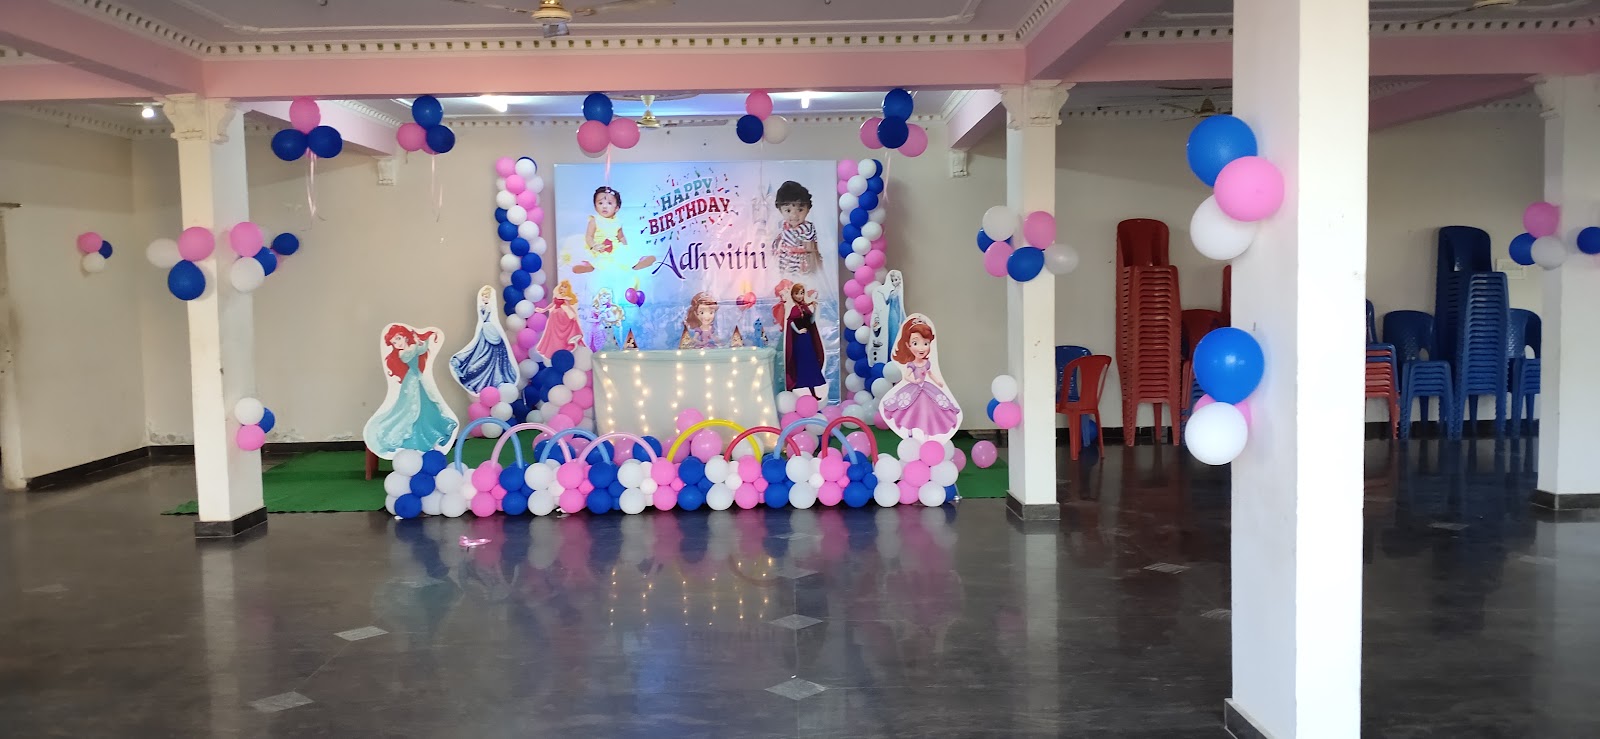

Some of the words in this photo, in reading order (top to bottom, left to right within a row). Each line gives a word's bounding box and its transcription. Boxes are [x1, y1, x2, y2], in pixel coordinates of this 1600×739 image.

[660, 178, 713, 212] HAPPY
[648, 197, 731, 235] BIRTHDAY
[651, 242, 768, 279] Adhvithi
